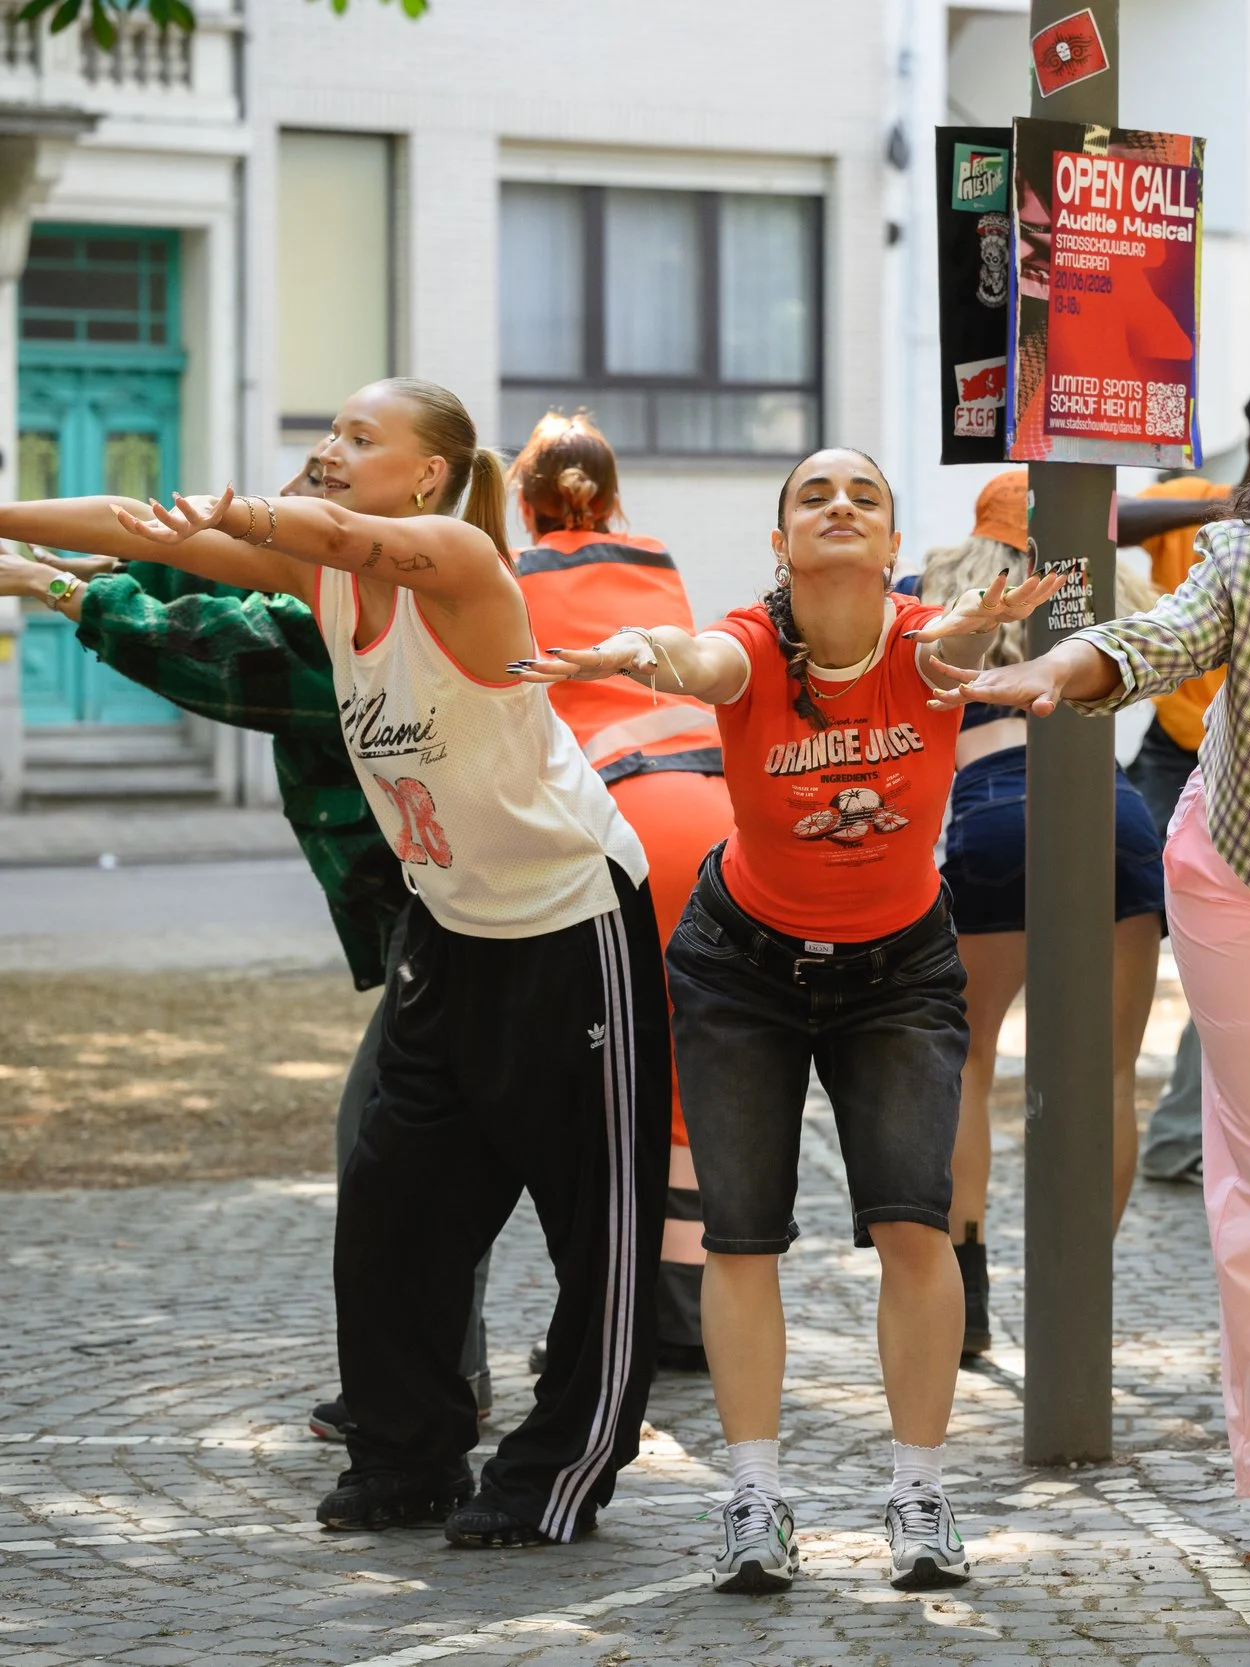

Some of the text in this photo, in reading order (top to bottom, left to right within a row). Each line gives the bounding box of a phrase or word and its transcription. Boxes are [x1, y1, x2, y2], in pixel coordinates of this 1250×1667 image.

[1056, 155, 1195, 219] OPEN CALL
[1056, 208, 1193, 242] Auditie Musical
[1055, 233, 1146, 258] STADSSCHOUWBURG
[1055, 251, 1110, 271] ANTWERPEN
[1054, 270, 1113, 294] 20/06/2026
[1051, 374, 1143, 399] LIMITED SPOTS
[955, 407, 995, 427] FIGA
[1050, 393, 1142, 419] SCHRIJF HIER IN!
[1049, 583, 1093, 601] ALKING
[1051, 597, 1087, 616] ABOUT
[1047, 611, 1096, 630] PALESTINE
[764, 728, 862, 777] ORANGE
